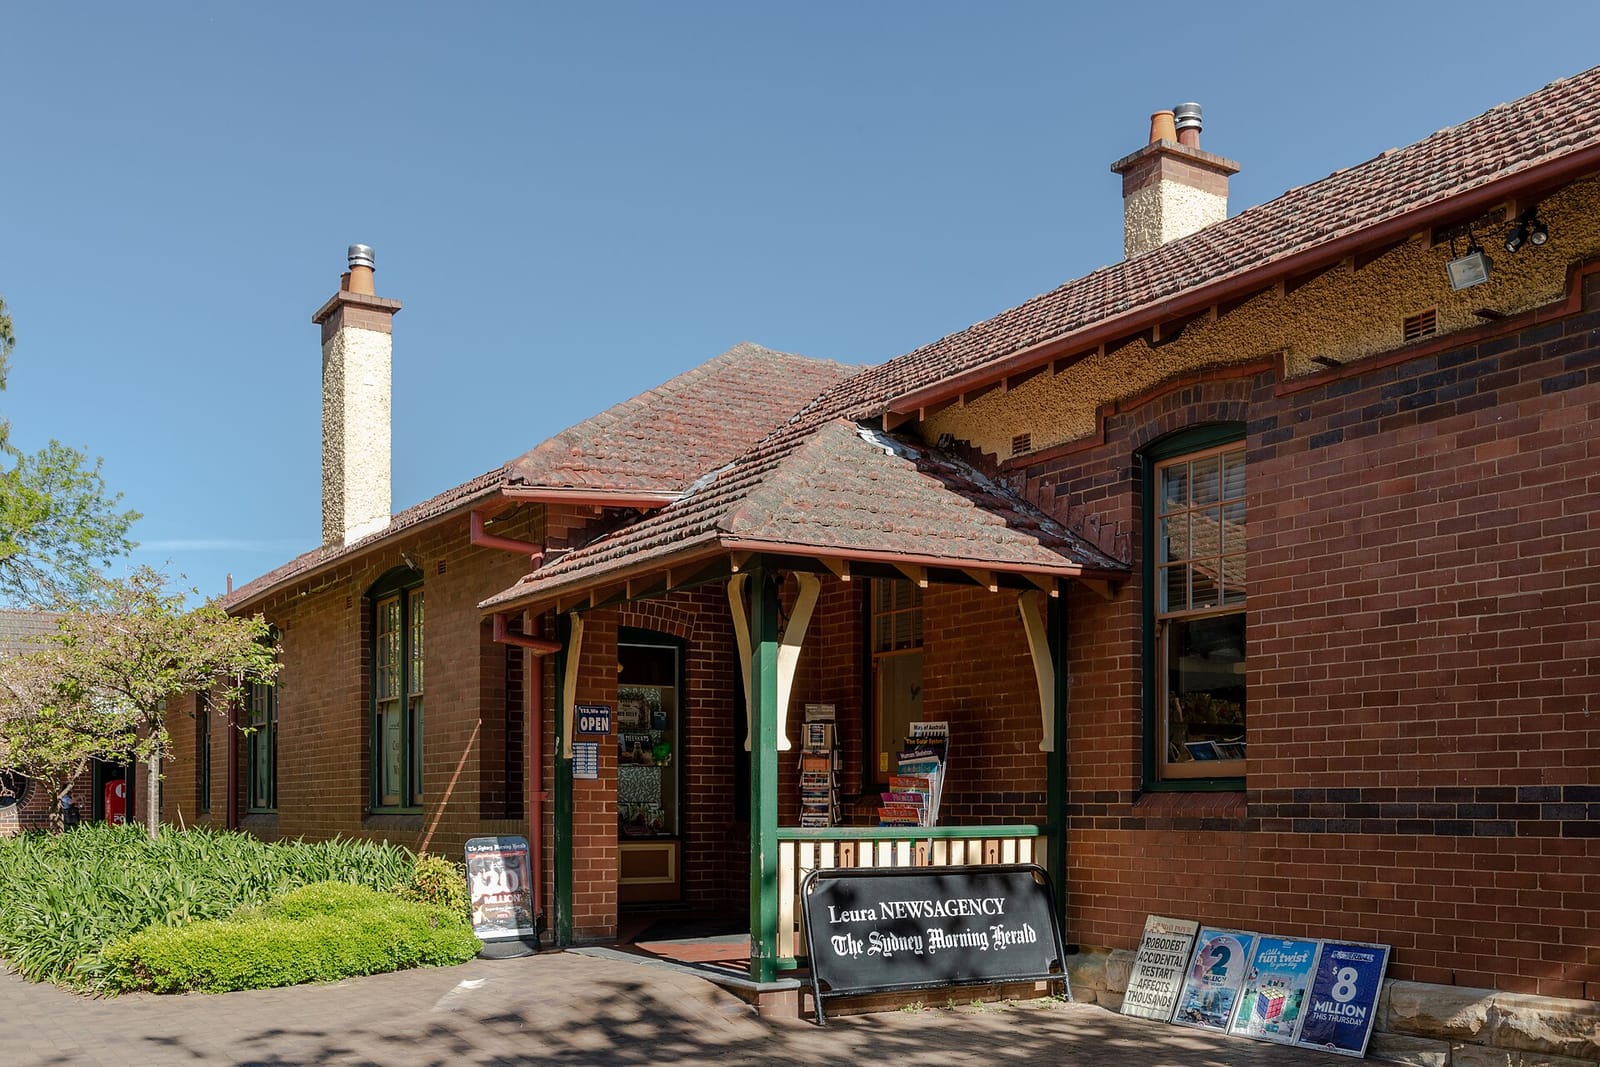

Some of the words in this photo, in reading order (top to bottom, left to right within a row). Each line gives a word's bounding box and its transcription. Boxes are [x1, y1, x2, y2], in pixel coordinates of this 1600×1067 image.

[580, 717, 608, 731] OPEN
[483, 894, 520, 904] MILLION
[828, 905, 877, 923] Leura
[879, 898, 1005, 920] NEWSAGENCY
[831, 933, 864, 959] The
[867, 931, 924, 957] Sydney
[927, 928, 989, 954] Morning
[989, 922, 1037, 951] Herald
[1145, 937, 1186, 951] ROBODEBT
[1138, 951, 1183, 967] ACCIDENTAL
[1258, 952, 1277, 963] fun
[1280, 952, 1308, 962] twist
[1140, 965, 1175, 980] RESTART
[1137, 979, 1170, 992] AFFECTS
[1331, 966, 1358, 1003] $8
[1127, 991, 1173, 1008] THOUSANDS
[1314, 1001, 1367, 1018] MILLION
[1312, 1012, 1328, 1020] THIS
[1328, 1014, 1364, 1026] THURSDAY
